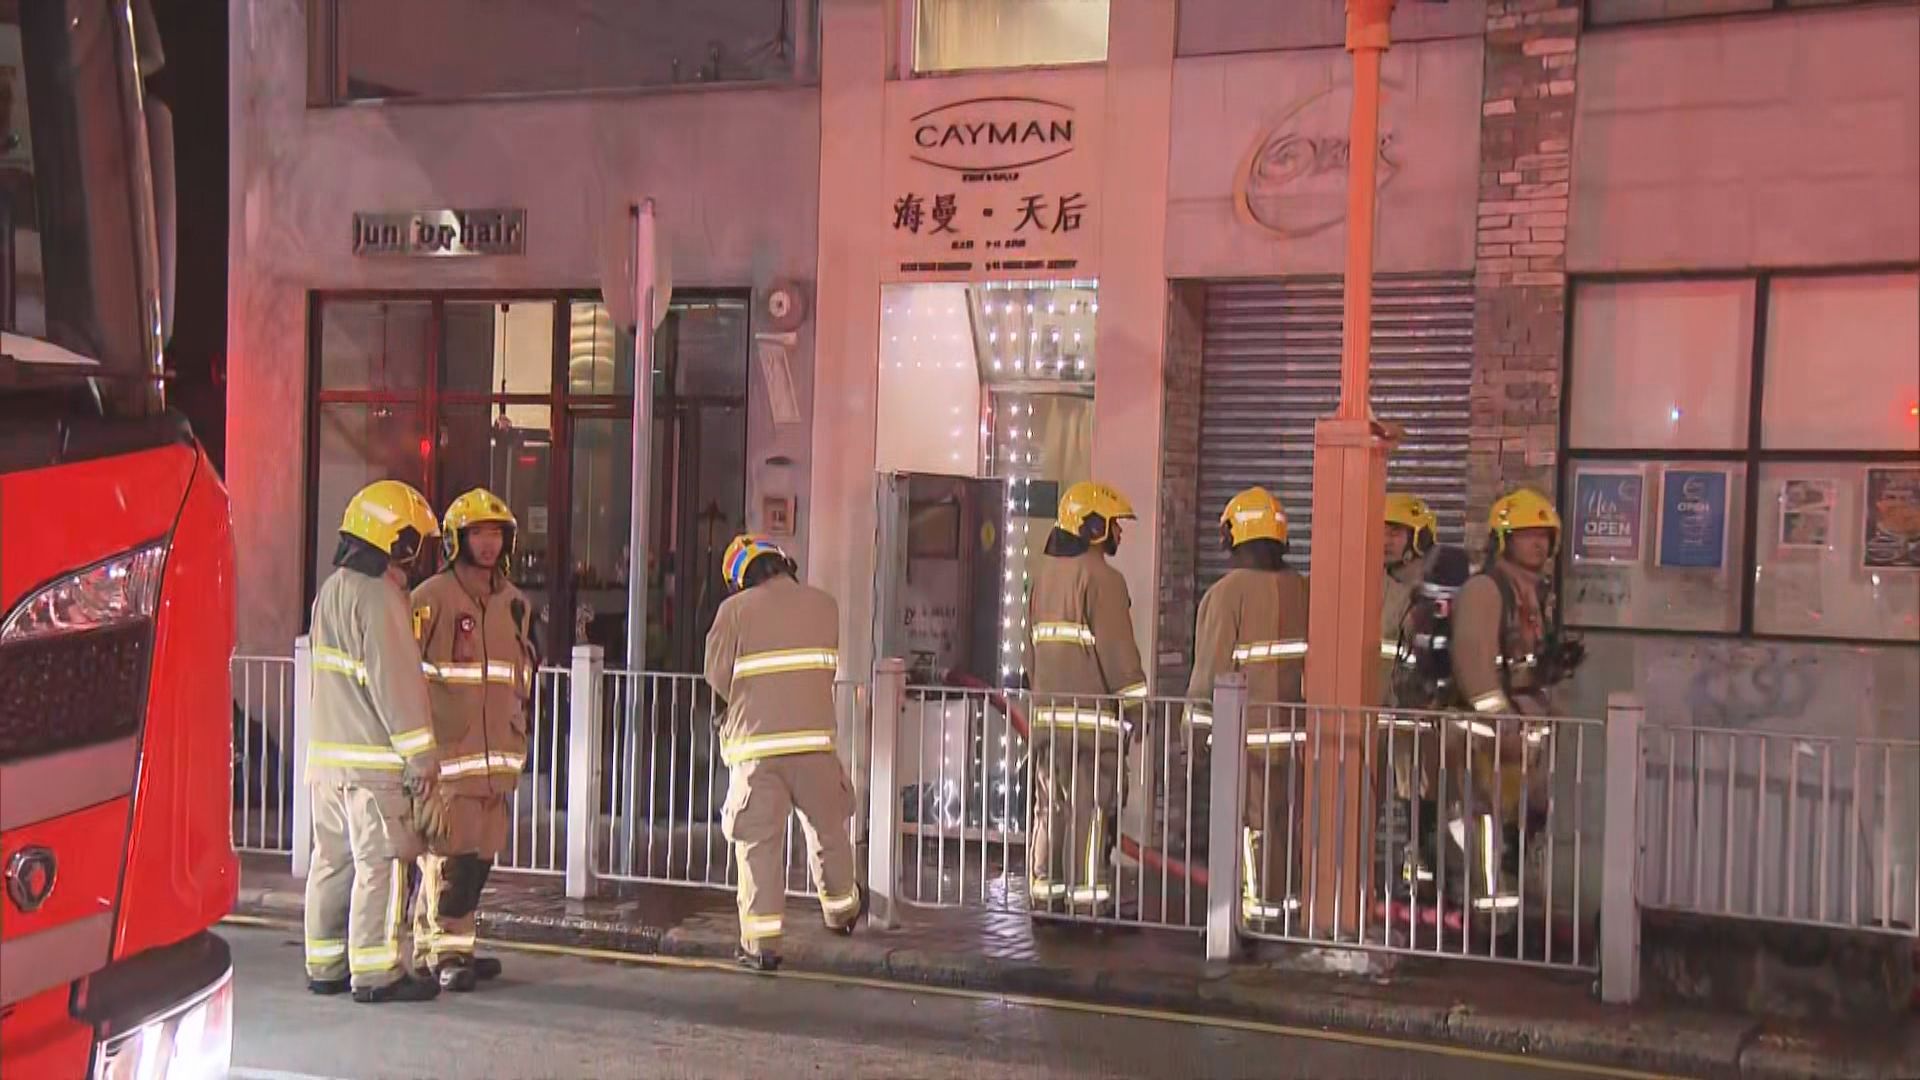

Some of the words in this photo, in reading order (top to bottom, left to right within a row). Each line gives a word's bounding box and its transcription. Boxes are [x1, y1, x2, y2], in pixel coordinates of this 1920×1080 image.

[914, 119, 1073, 148] CAYMAN
[410, 214, 457, 252] for
[461, 213, 521, 248] hair
[1584, 521, 1631, 536] OPEN
